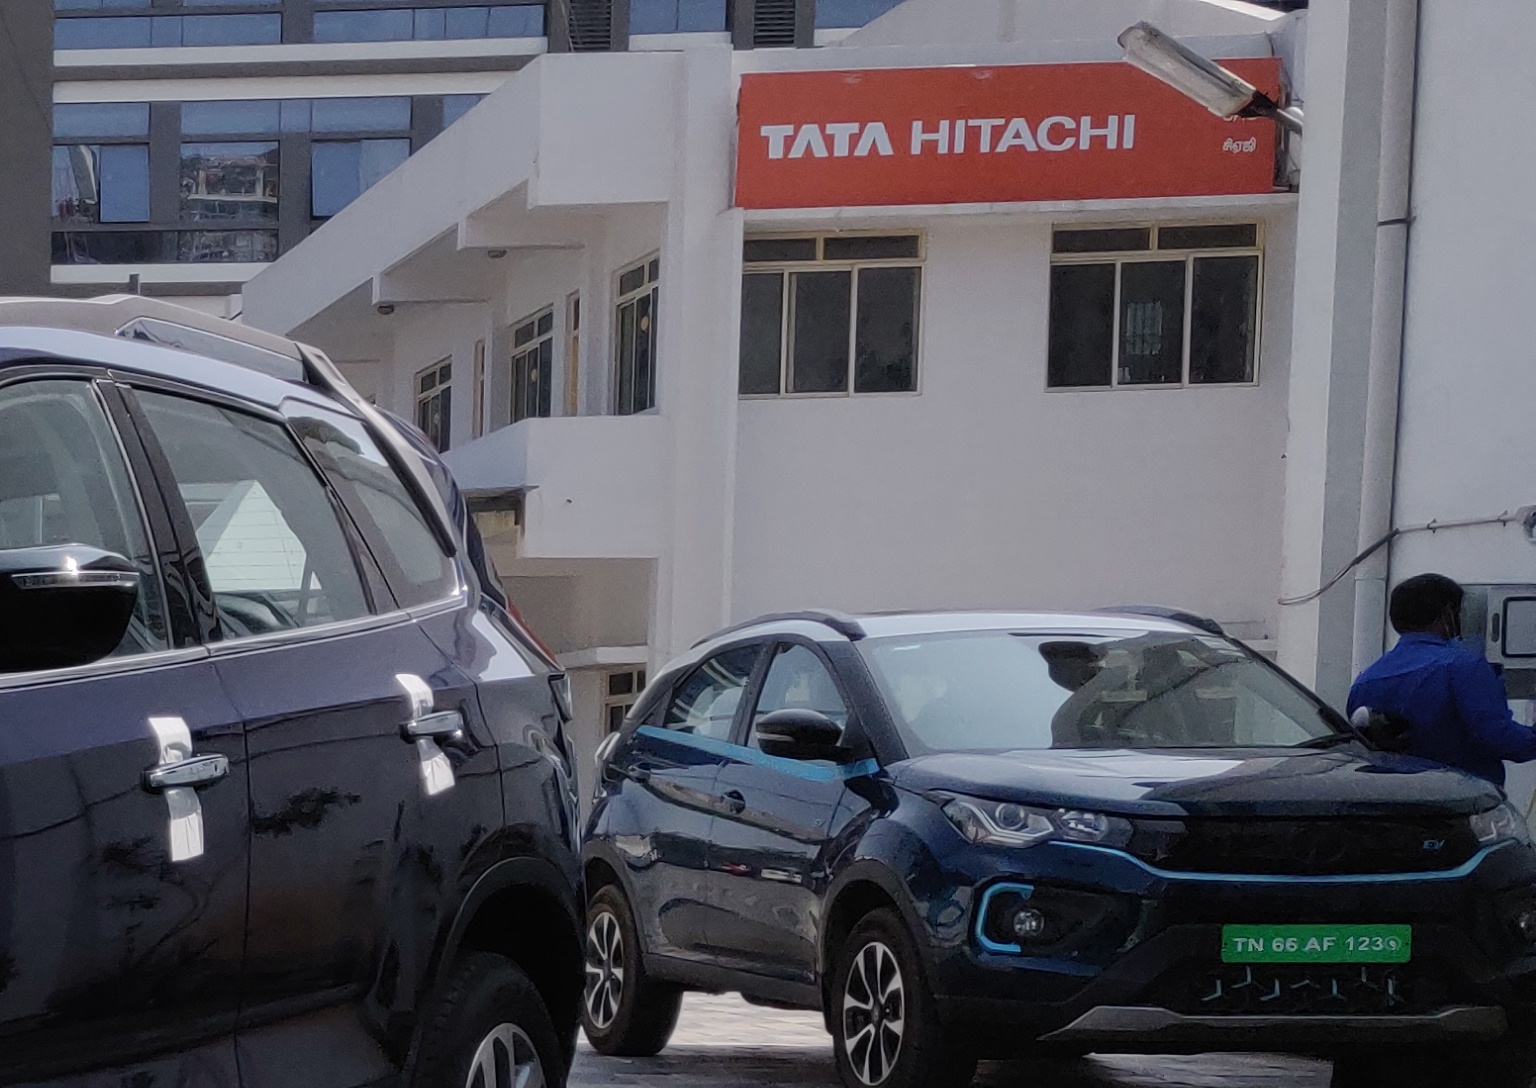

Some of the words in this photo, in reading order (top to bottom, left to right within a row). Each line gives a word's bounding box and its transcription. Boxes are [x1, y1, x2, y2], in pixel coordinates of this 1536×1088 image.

[760, 122, 893, 159] TATA
[911, 114, 1136, 155] HITACHI
[1233, 937, 1264, 952] TN
[1302, 937, 1337, 952] AF
